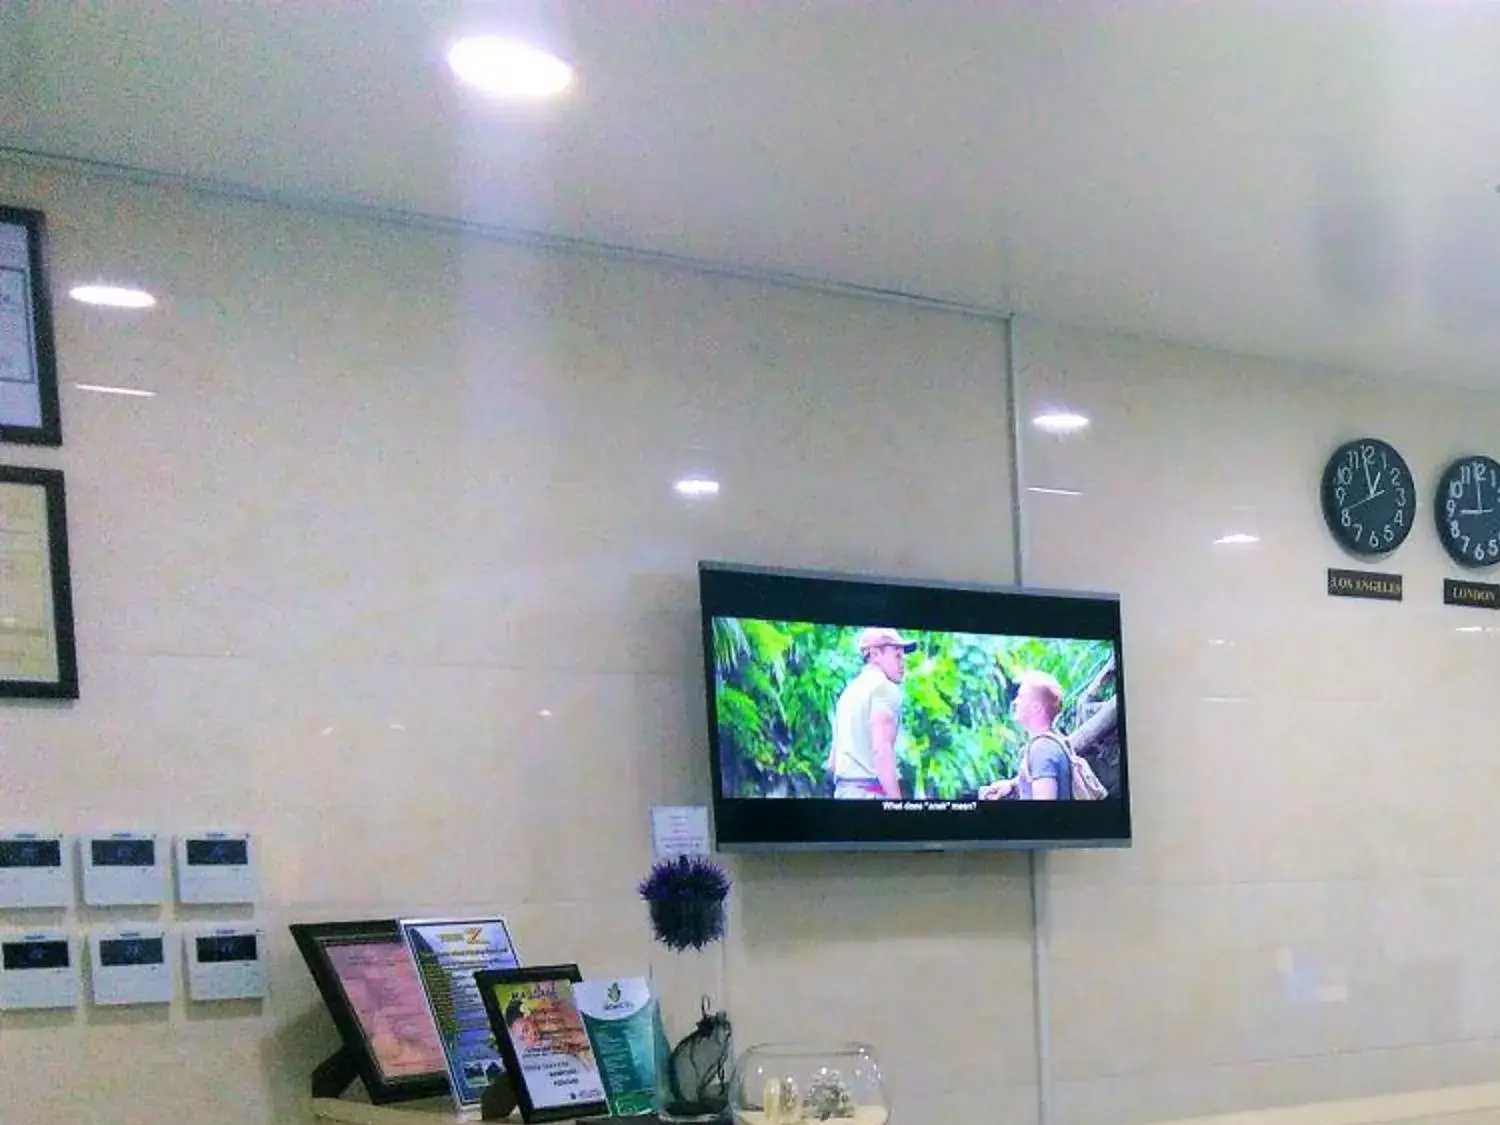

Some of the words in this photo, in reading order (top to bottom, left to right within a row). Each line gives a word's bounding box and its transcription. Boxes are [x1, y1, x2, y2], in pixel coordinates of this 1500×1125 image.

[1347, 451, 1359, 471] 11
[1360, 444, 1375, 465] 12
[1337, 466, 1352, 485] 10
[1390, 467, 1400, 486] 2
[1460, 464, 1470, 484] 11
[1472, 462, 1487, 480] 12
[1336, 486, 1346, 506] 9
[1395, 487, 1406, 507] 3
[1449, 480, 1463, 499] 10
[1341, 508, 1351, 526] 8
[1394, 509, 1404, 526] 4
[1446, 500, 1456, 519] 9
[1352, 523, 1363, 543] 7
[1384, 524, 1394, 542] 5
[1450, 520, 1460, 538] 8
[1369, 530, 1379, 547] 6
[1461, 536, 1470, 553] 7
[1487, 539, 1498, 556] 5
[1474, 544, 1485, 560] 6
[1452, 585, 1496, 601] LONDON
